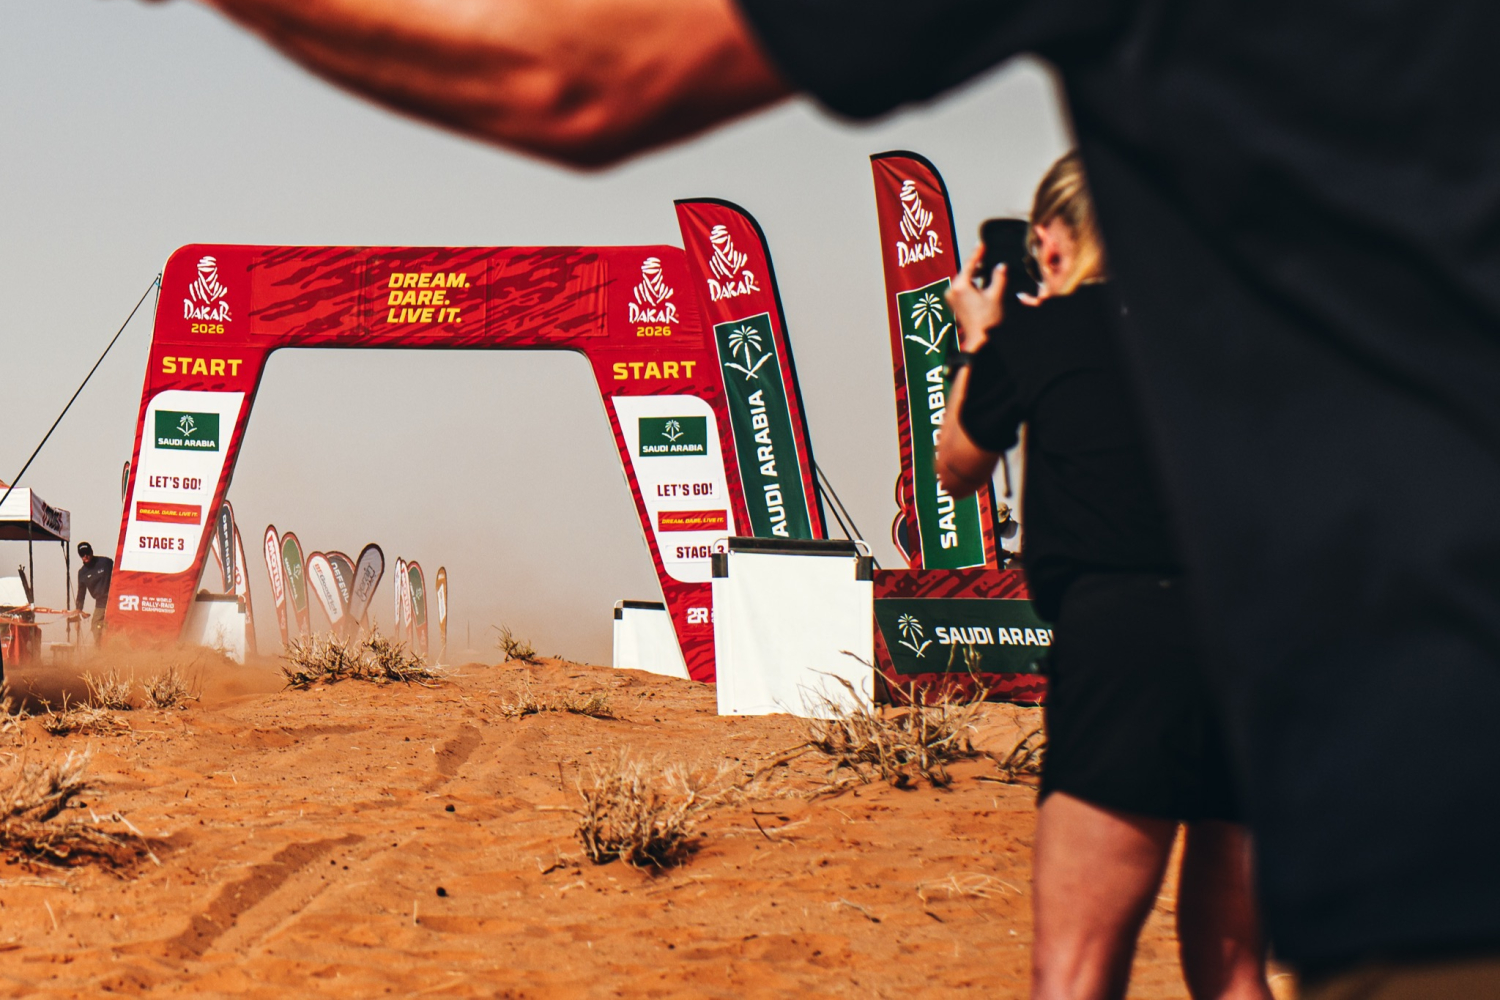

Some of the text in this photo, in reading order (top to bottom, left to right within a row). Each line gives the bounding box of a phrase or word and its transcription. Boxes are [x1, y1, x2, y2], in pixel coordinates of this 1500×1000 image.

[896, 230, 943, 268] DAKAR
[388, 273, 471, 288] DREAM.
[707, 270, 761, 302] DAKAR
[387, 290, 451, 305] DARE.
[183, 298, 232, 322] DAKAR
[386, 308, 462, 323] LIVE IT.
[628, 302, 680, 324] DAKAR
[191, 323, 225, 334] 2026
[636, 326, 672, 337] 2026
[162, 356, 243, 376] START
[612, 361, 697, 380] START
[158, 437, 216, 448] SAUDI ARABIA
[642, 443, 704, 453] SAUDI ARABIA
[748, 389, 790, 538] AUDI ARABIA
[149, 475, 202, 490] LET'S GO!
[657, 482, 713, 497] LET'S GO!
[936, 473, 958, 550] SAU
[139, 536, 185, 551] STAGE 3
[222, 513, 231, 584] DEFENDER
[267, 540, 283, 599] MOTUL
[331, 562, 349, 604] DEFEN
[119, 595, 140, 611] 2R
[142, 600, 175, 608] RALLY-RAID
[687, 607, 709, 624] 2R
[935, 626, 1055, 646] SAUDI ARABI
